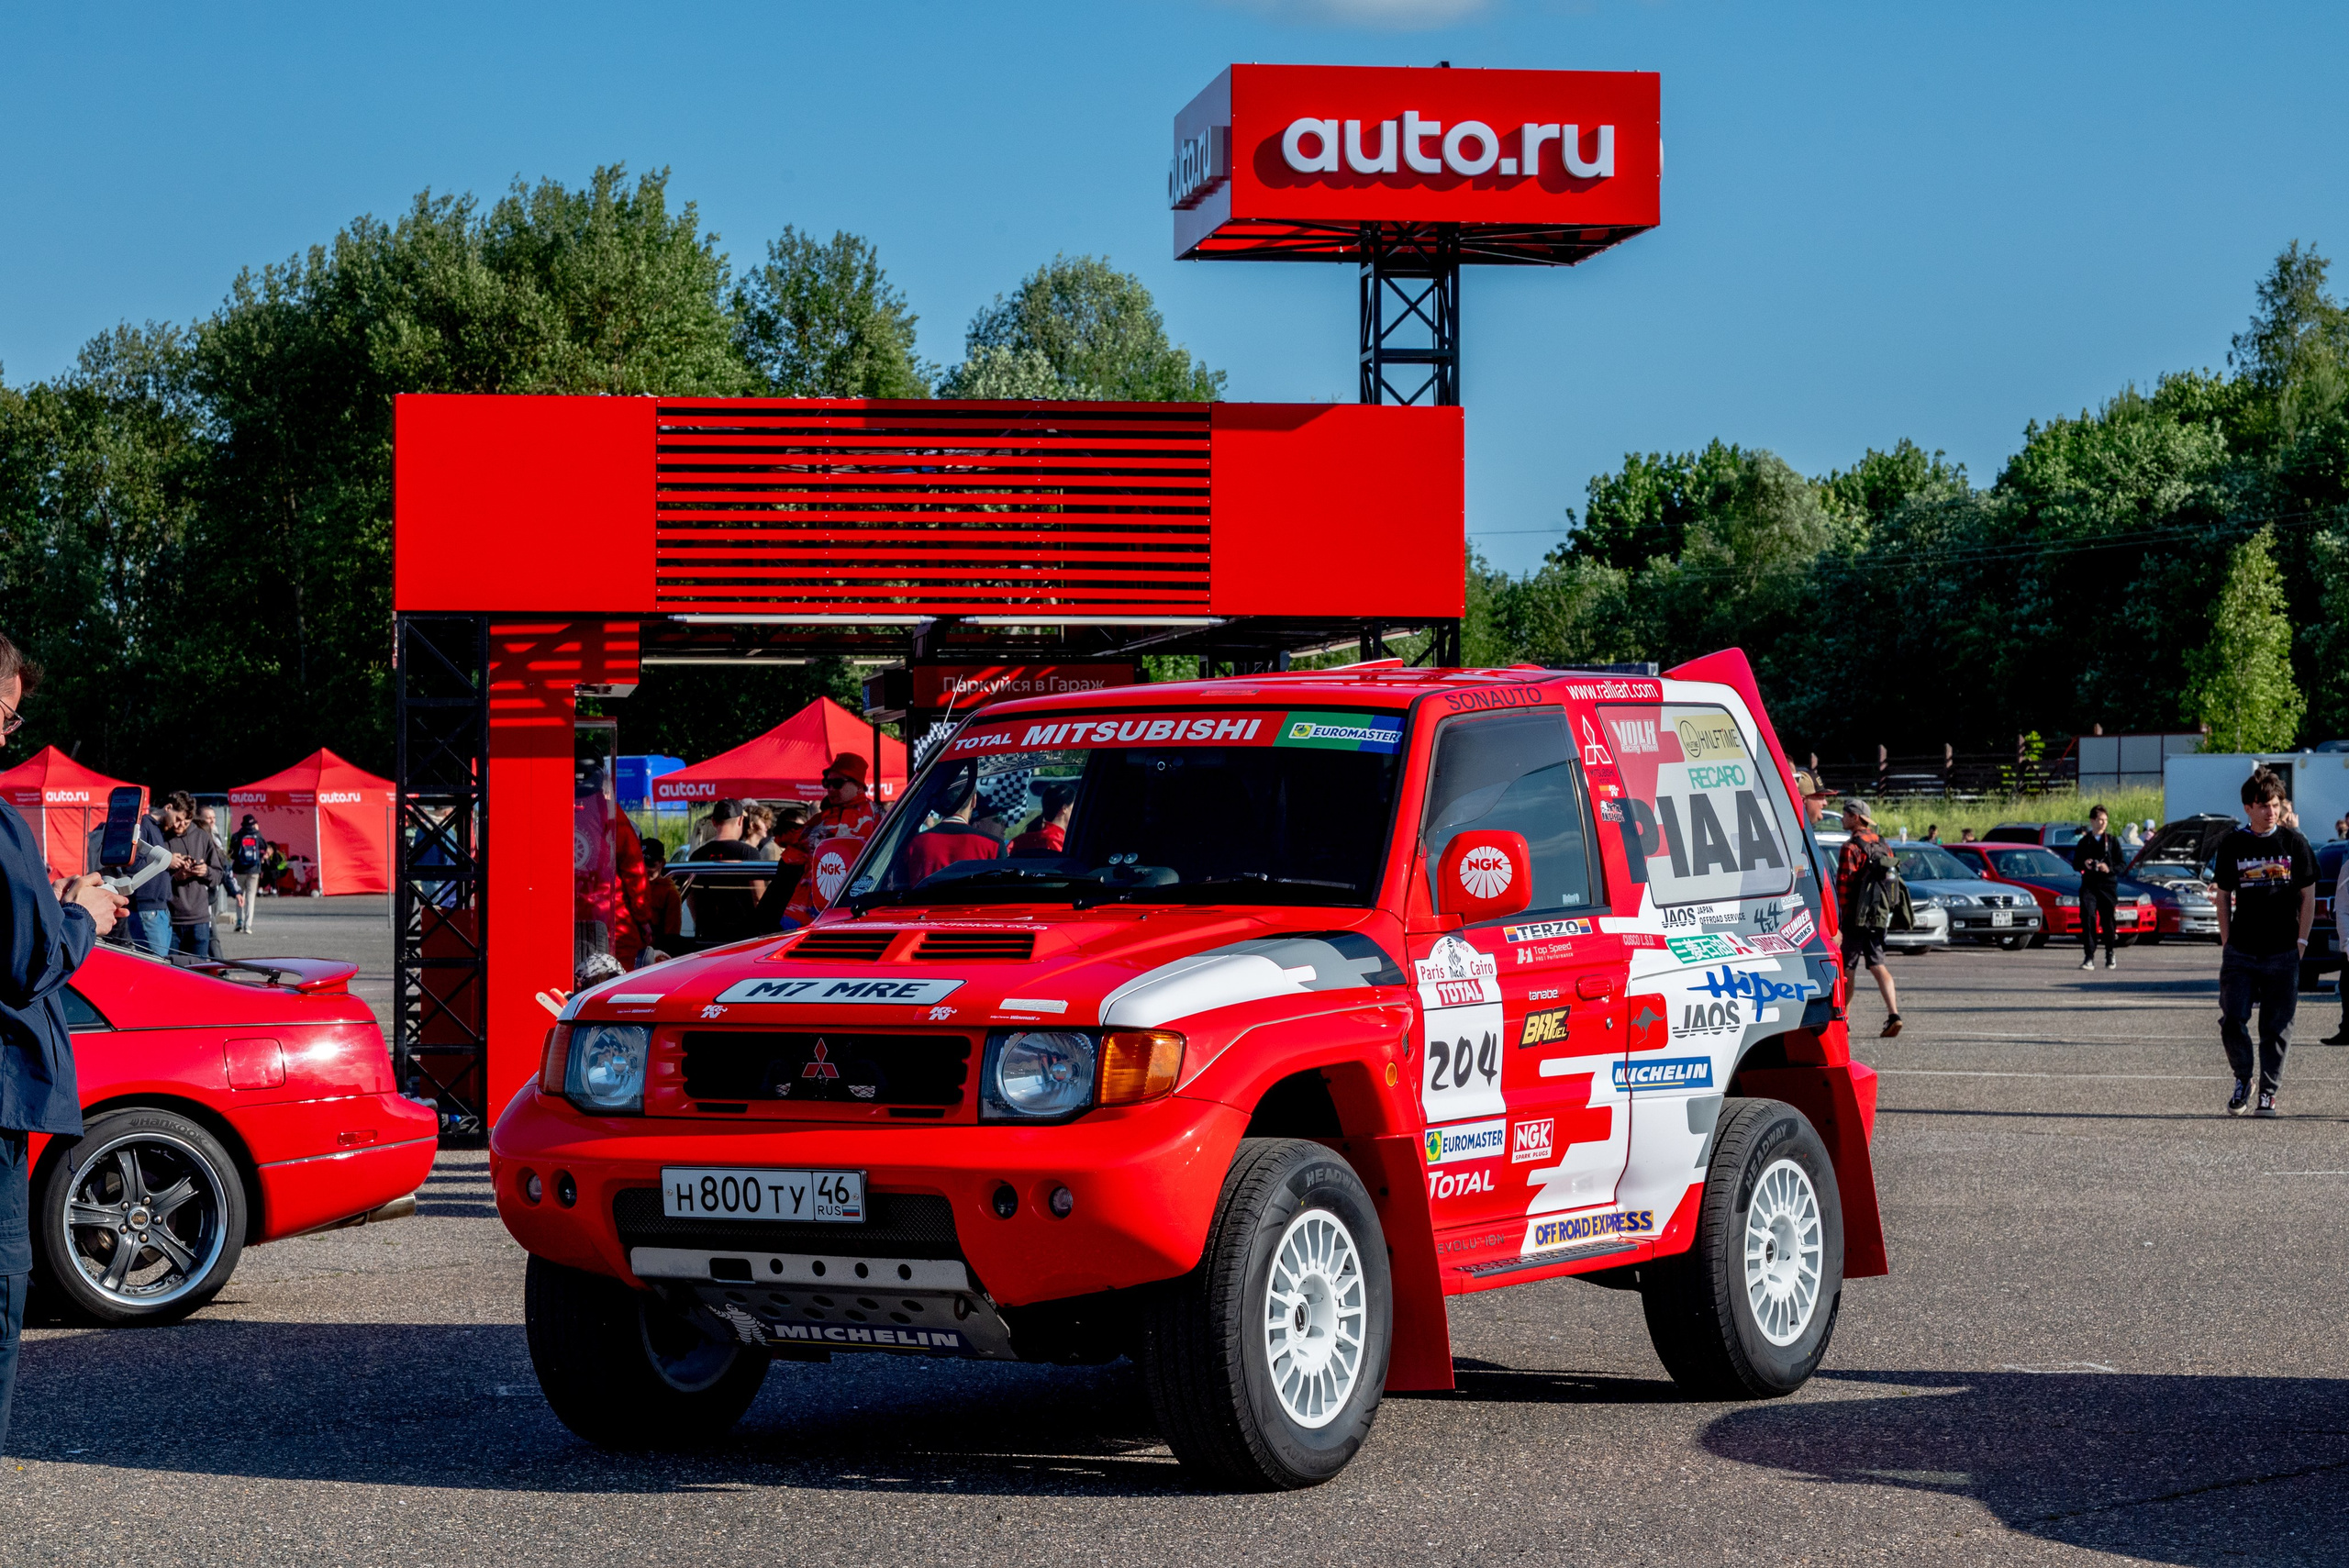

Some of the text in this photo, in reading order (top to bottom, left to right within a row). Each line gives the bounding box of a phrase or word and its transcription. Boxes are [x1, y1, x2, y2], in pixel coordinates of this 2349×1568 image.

[1282, 110, 1615, 178] auto.ru
[1168, 126, 1211, 210] auto.ru
[943, 676, 1105, 695] Паркуйся в Гараж
[1565, 681, 1659, 700] www.ralliart.com
[1444, 687, 1542, 711] SONAUTO
[954, 718, 1263, 751] TOTAL MITSUBISHI
[1312, 727, 1399, 742] EUROMASTER
[1609, 719, 1657, 746] VOLK
[1698, 728, 1741, 750] HALFTIME
[1620, 742, 1660, 755] Racing Wheel
[1687, 764, 1746, 789] RECARO
[45, 790, 90, 803] auto.ru
[230, 792, 267, 804] auto.ru
[319, 792, 362, 804] auto.ru
[658, 783, 716, 797] auto.ru
[1612, 790, 1785, 884] PIAA
[820, 862, 841, 875] NGK
[1467, 857, 1503, 871] NGK
[1661, 907, 1697, 929] JAOS
[1698, 906, 1714, 915] JAPAN
[1699, 912, 1746, 925] OFFROAD SERVICE
[1517, 920, 1579, 940] TERZO
[1780, 908, 1811, 939] CYLINDER
[1793, 925, 1812, 944] WORKS
[1533, 941, 1572, 955] Top Speed
[1623, 934, 1641, 946] CUSCO
[1670, 936, 1736, 962] 三菱石油
[1420, 961, 1494, 981] Paris Cairo
[745, 982, 930, 997] M7 MRE
[1438, 981, 1483, 1004] TOTAL
[1672, 1000, 1741, 1039] JAOS
[1429, 1030, 1497, 1092] 204
[1614, 1062, 1709, 1084] MICHELIN
[1442, 1129, 1503, 1153] EUROMASTER
[1516, 1122, 1552, 1151] NGK
[1515, 1152, 1531, 1161] SPARK
[1745, 1124, 1788, 1191] HEADWAY
[818, 1176, 850, 1204] 46
[1429, 1170, 1495, 1199] TOTAL
[818, 1206, 841, 1216] RUS
[1535, 1211, 1653, 1246] OFF ROAD EXPRESS
[774, 1323, 959, 1348] MICHELIN
